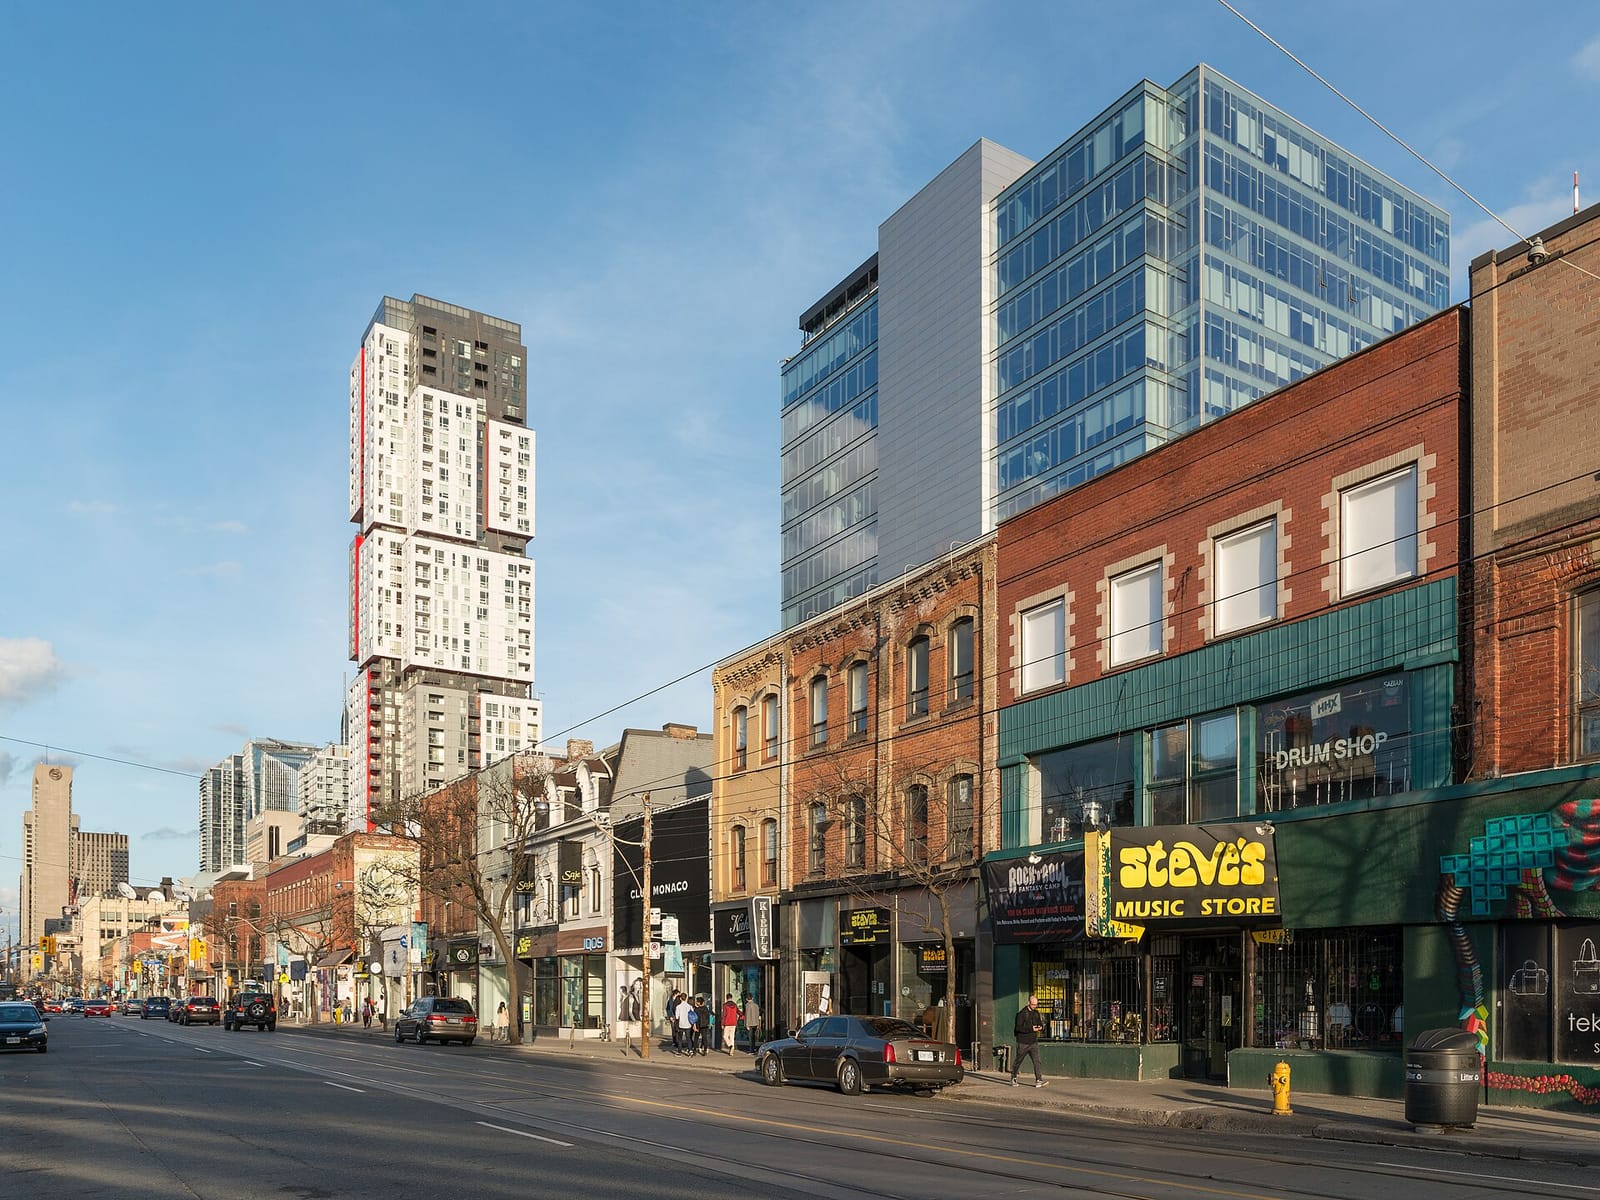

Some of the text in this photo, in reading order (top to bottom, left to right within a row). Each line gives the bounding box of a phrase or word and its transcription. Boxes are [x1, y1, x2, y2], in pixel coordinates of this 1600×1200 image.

[1317, 695, 1338, 714] HHX
[1276, 731, 1388, 770] DRUM SHOP
[652, 880, 689, 896] MONACO
[1018, 884, 1043, 893] FANTASY
[1044, 882, 1061, 891] CAMP
[1115, 897, 1275, 918] MUSIC STORE
[1460, 1072, 1474, 1081] Litter
